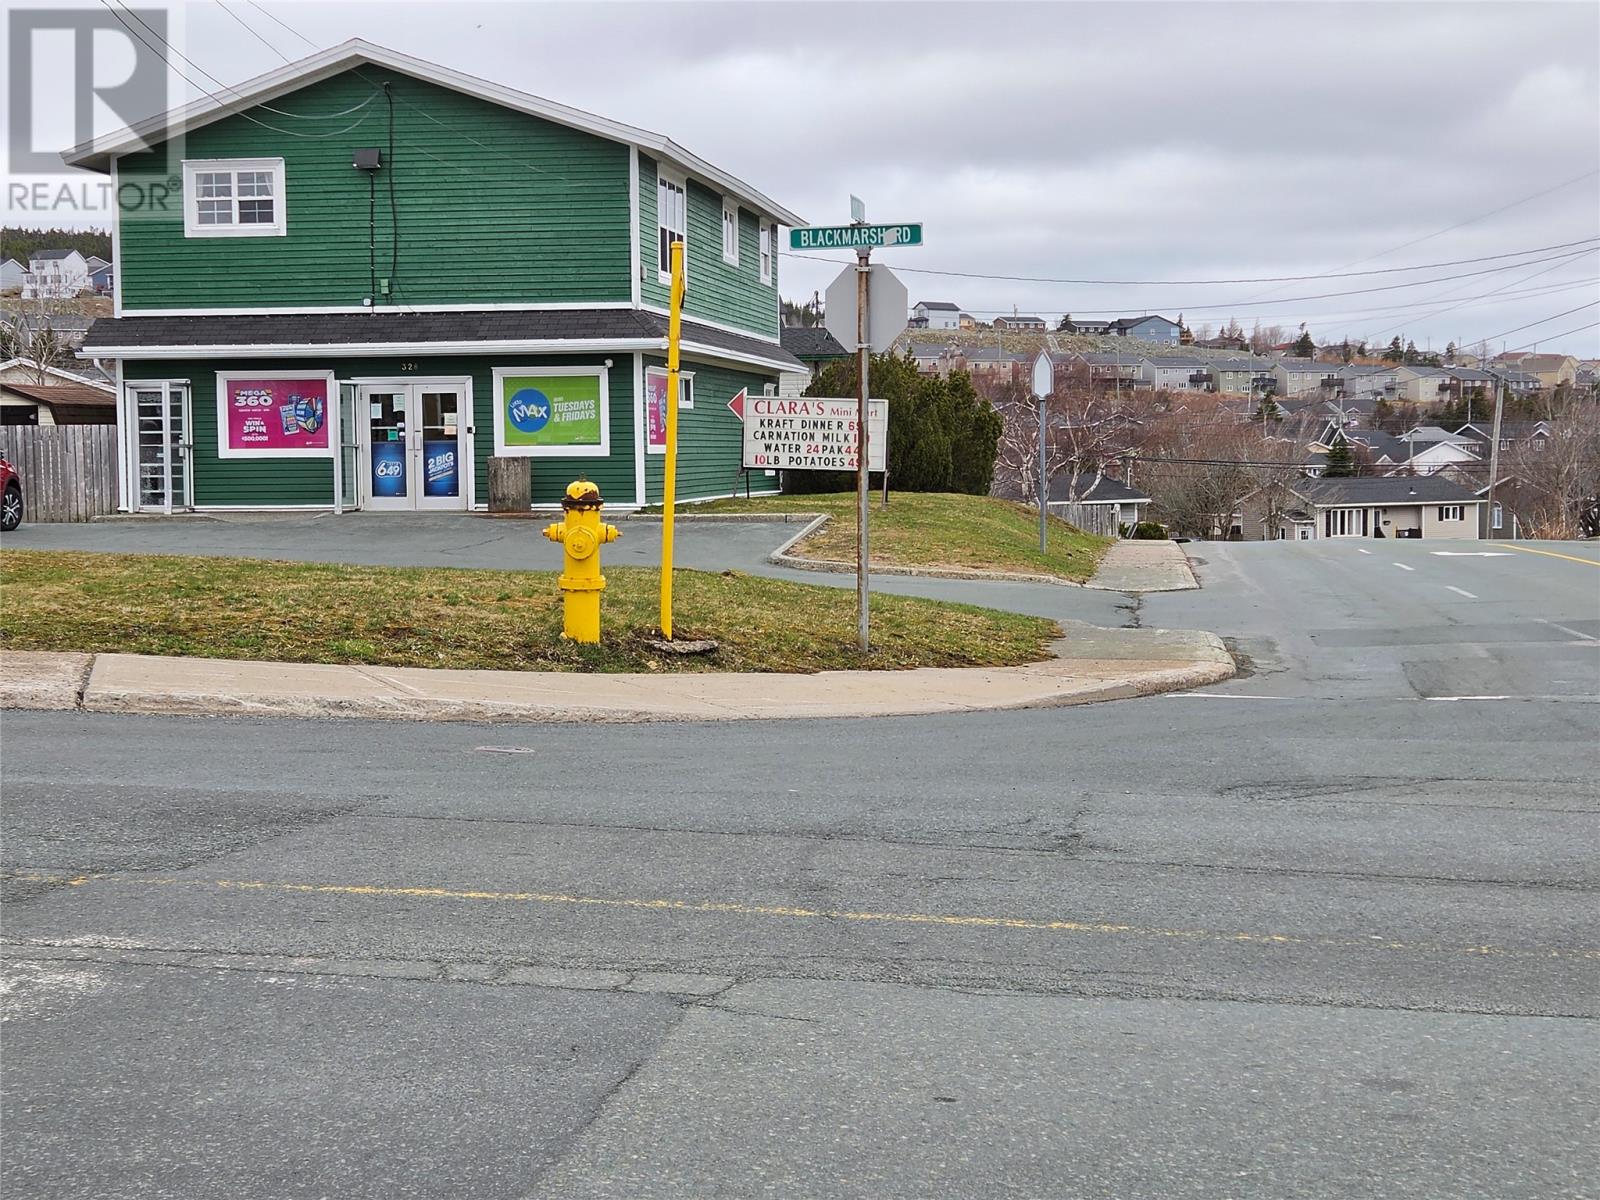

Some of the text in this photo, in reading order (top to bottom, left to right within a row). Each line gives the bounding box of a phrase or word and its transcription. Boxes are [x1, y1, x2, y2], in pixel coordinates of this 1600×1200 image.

[801, 227, 911, 246] BLACKMARSH RD
[234, 396, 273, 406] 360
[553, 400, 595, 412] TUESDAYS
[513, 404, 547, 422] MAX
[754, 400, 825, 415] CLARA'S
[830, 408, 852, 416] Mini
[553, 410, 596, 422] & FRIDAYS
[760, 419, 794, 429] KRAFT
[753, 431, 815, 442] CARNATION
[822, 433, 850, 443] MILK
[764, 443, 801, 453] WATER
[428, 452, 454, 470] 2 BIG
[755, 455, 780, 465] 10LB
[789, 456, 845, 467] POTATOES
